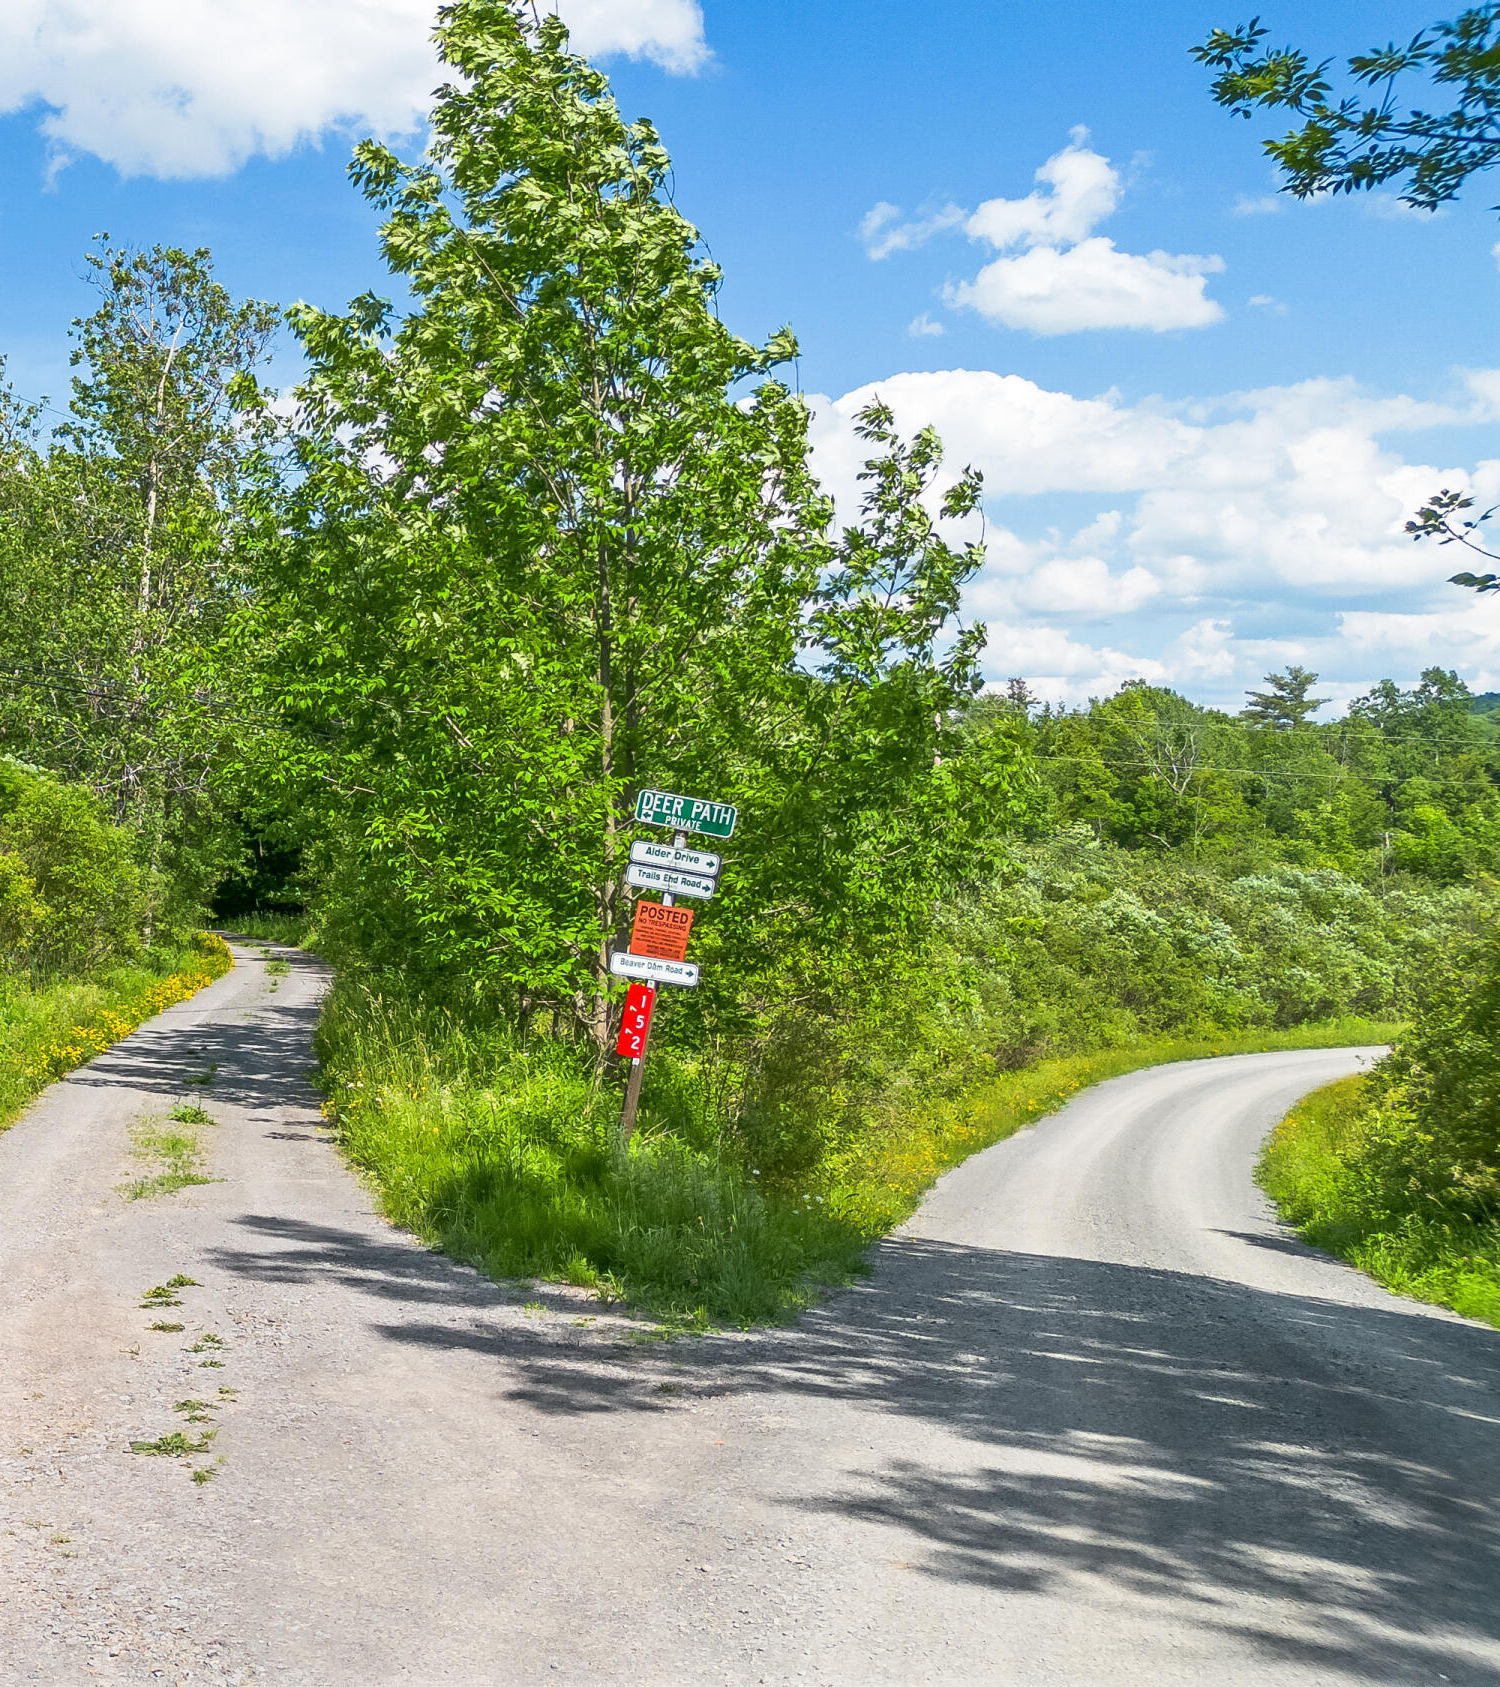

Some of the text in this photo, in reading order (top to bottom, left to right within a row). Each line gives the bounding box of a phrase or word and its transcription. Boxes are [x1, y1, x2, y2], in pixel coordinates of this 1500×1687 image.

[642, 793, 732, 825] DEER PATH
[665, 816, 702, 830] PRIVATE
[645, 847, 671, 858] Alder
[674, 852, 699, 864] Drive
[638, 869, 661, 881] Trails
[663, 873, 679, 884] End
[681, 878, 702, 888] Road
[640, 905, 689, 925] POSTED
[639, 917, 687, 932] NO TRESPASSING
[620, 958, 645, 968] Beaver
[665, 965, 683, 975] Road
